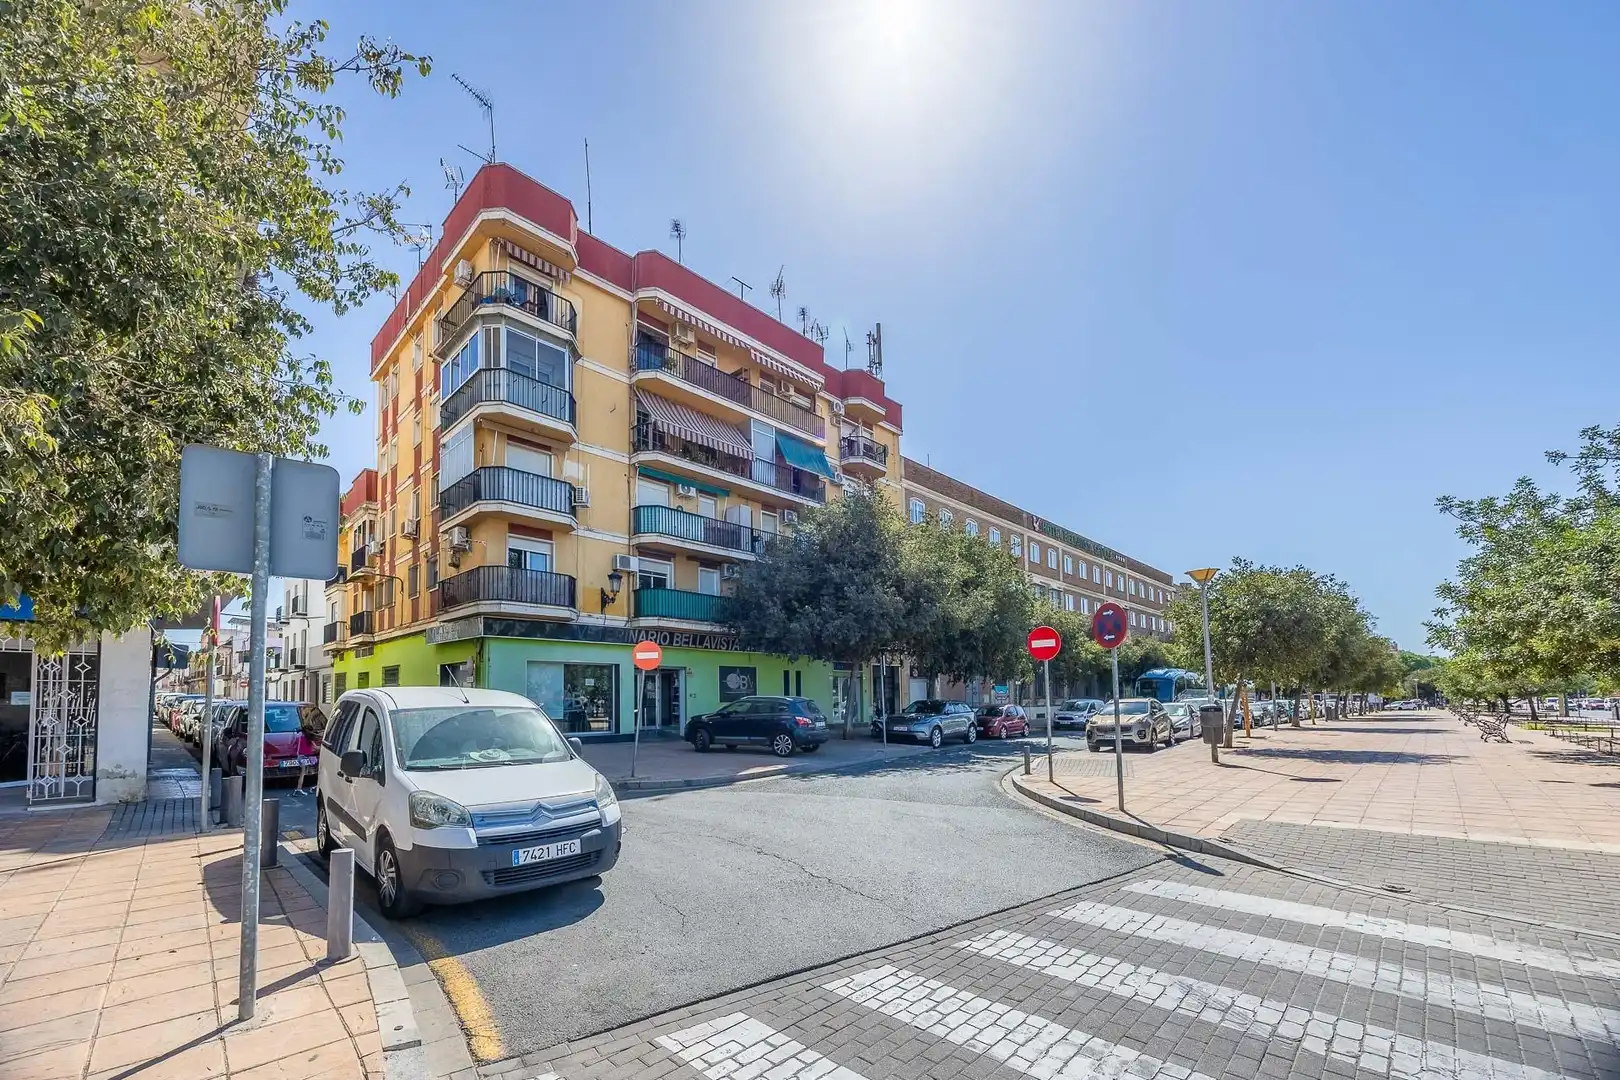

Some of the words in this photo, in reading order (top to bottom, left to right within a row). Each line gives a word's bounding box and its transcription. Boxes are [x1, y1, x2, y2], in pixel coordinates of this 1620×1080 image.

[673, 632, 740, 651] BELLAVISTA
[523, 846, 550, 862] 7421
[556, 842, 576, 856] HFC
